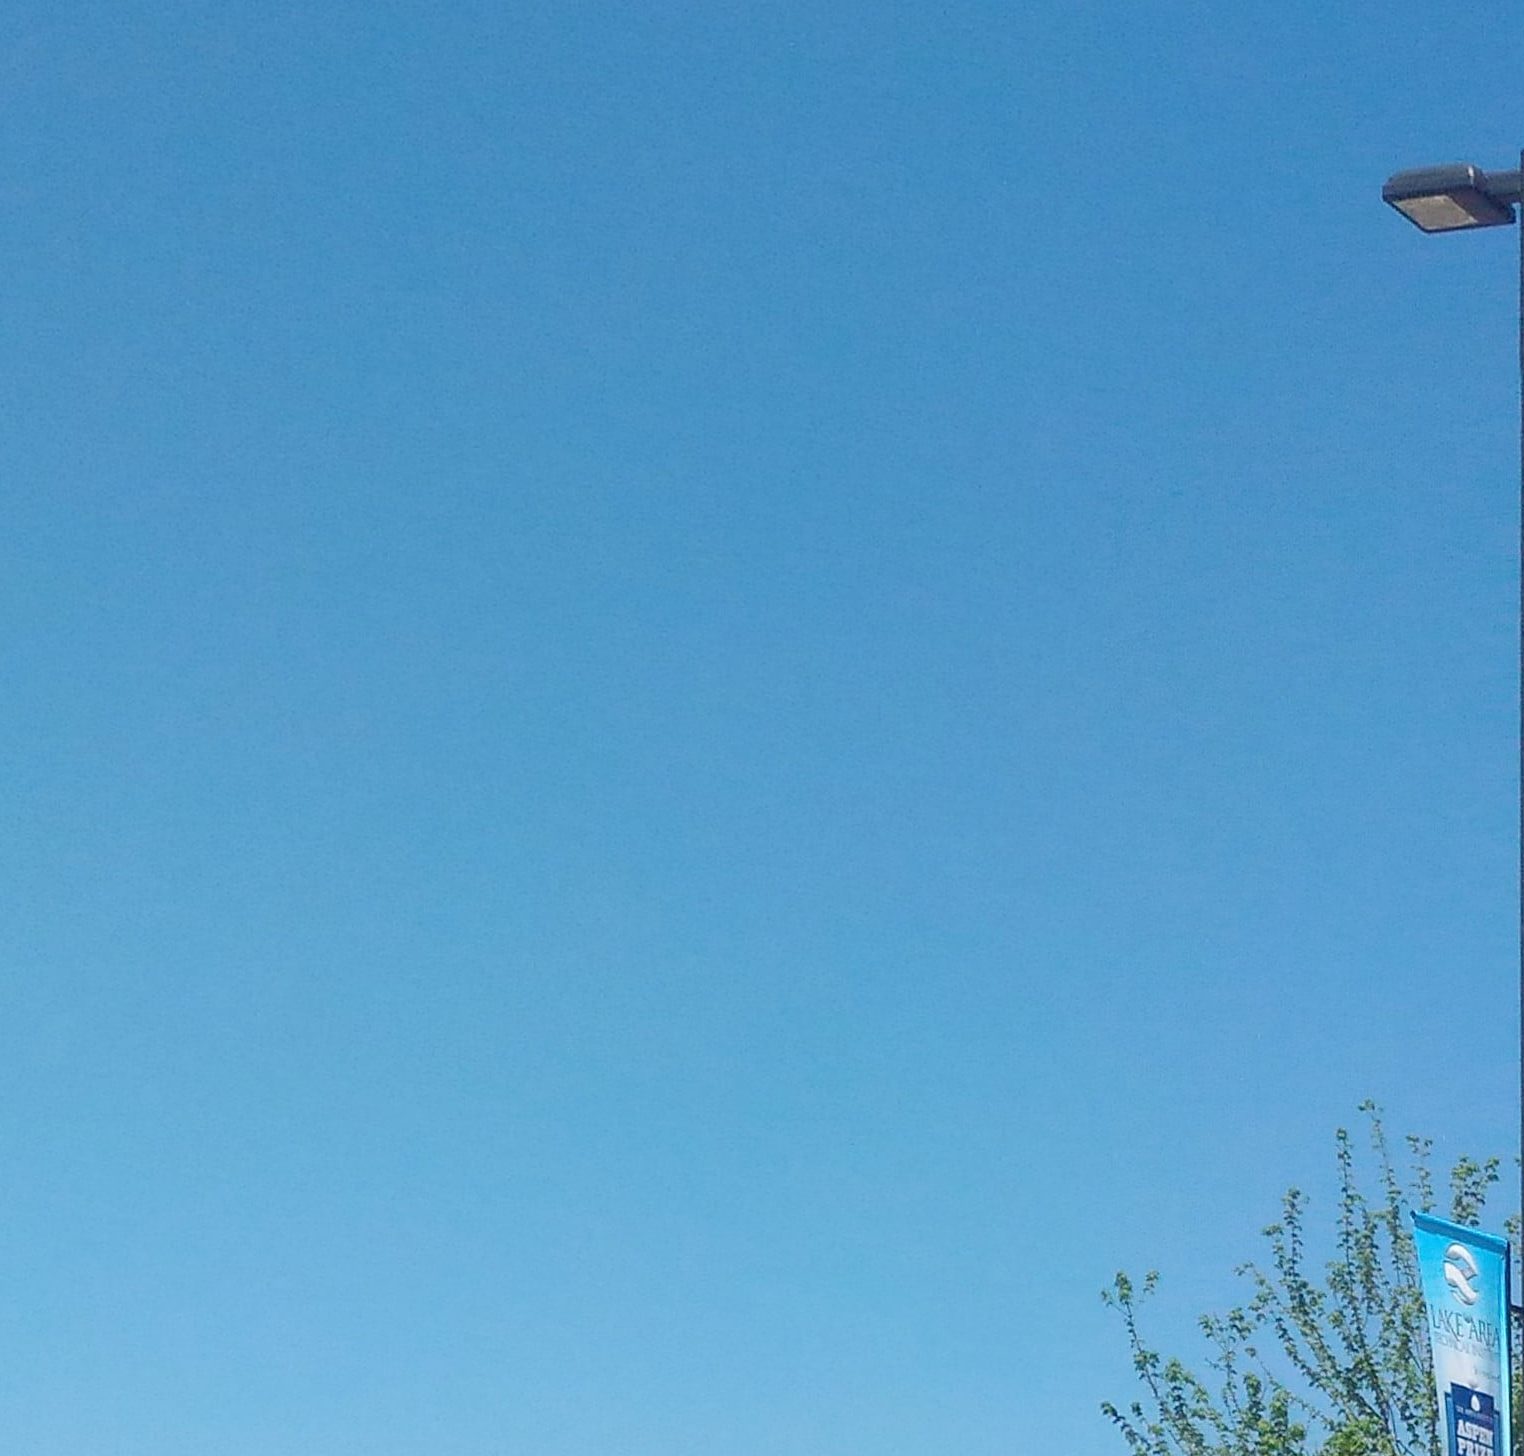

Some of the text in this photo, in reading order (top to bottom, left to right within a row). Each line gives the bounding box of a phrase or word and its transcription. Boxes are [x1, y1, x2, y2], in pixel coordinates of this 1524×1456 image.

[1430, 1304, 1463, 1341] LAKE
[1469, 1316, 1501, 1347] AREA
[1457, 1419, 1494, 1447] ASPEN
